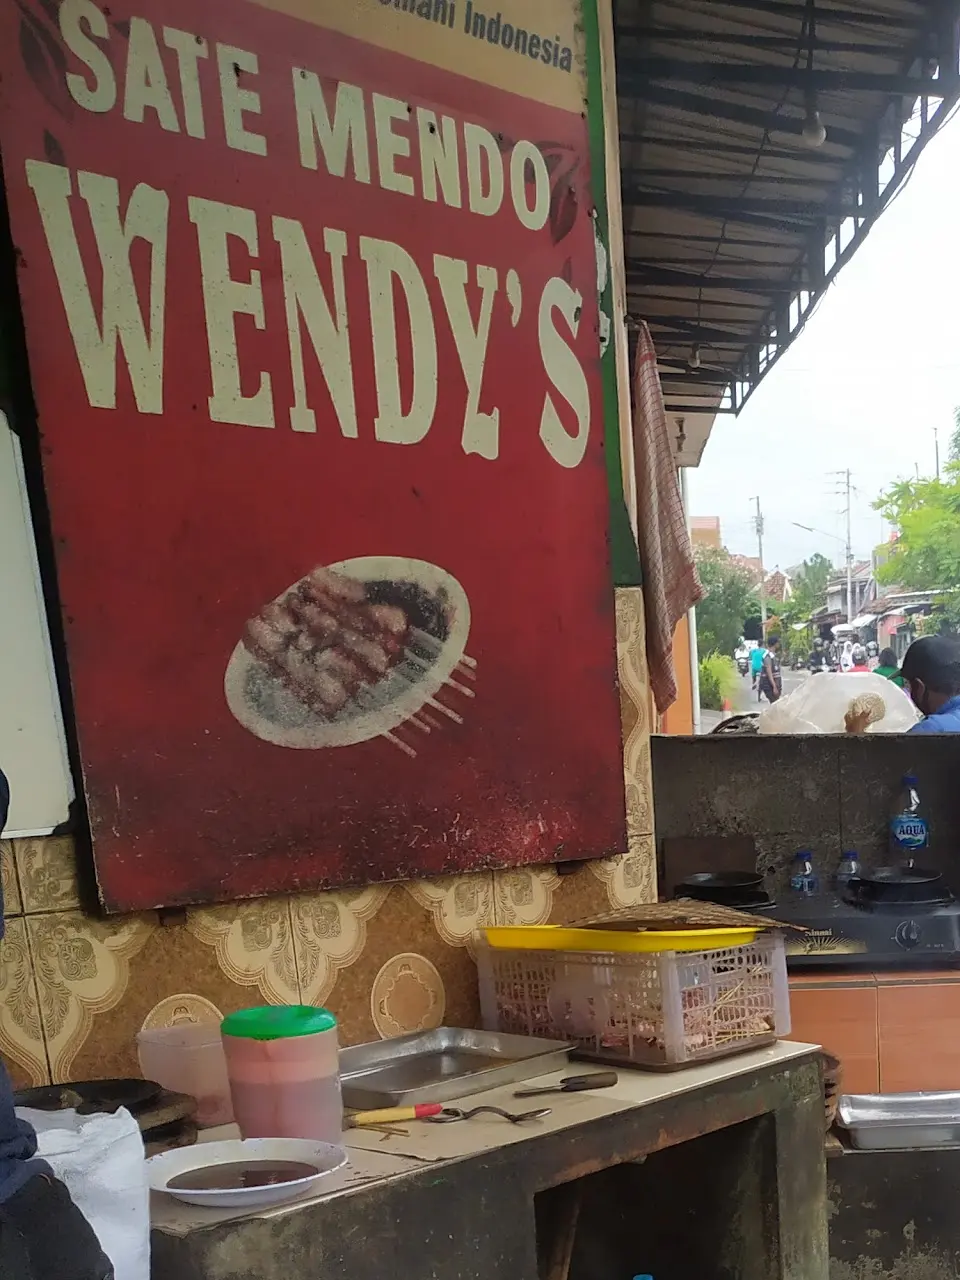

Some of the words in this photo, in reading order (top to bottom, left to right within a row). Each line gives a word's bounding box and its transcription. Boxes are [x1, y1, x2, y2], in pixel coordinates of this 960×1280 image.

[464, 1, 573, 73] Indonesia
[58, 0, 268, 156] SATE
[292, 66, 551, 230] MENDO
[25, 159, 591, 469] WENDY'S
[899, 824, 925, 836] AQUA
